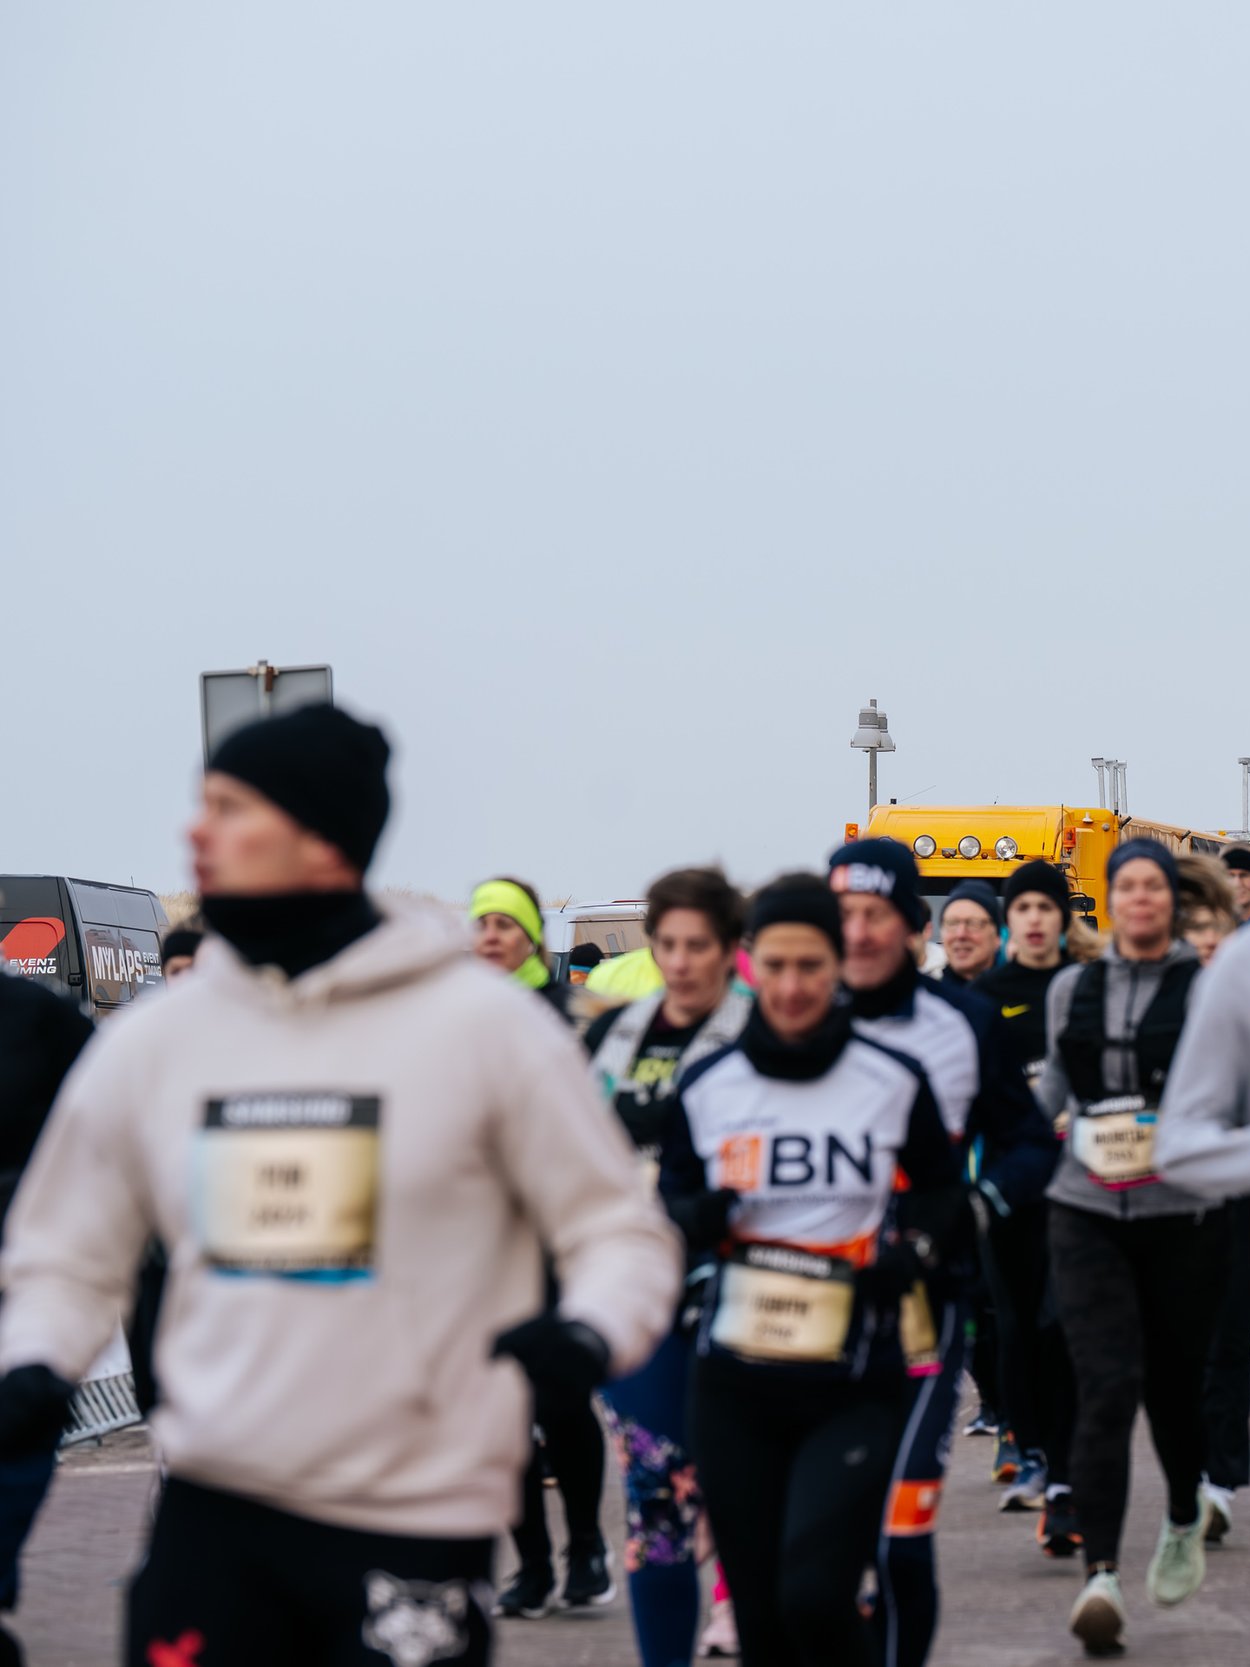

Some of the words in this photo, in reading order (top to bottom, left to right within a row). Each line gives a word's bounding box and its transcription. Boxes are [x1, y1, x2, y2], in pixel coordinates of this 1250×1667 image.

[9, 957, 57, 966] EVENT
[143, 952, 160, 964] EVENT
[15, 966, 57, 975] MING
[92, 945, 145, 984] MYLAPS
[144, 965, 162, 977] TIMING
